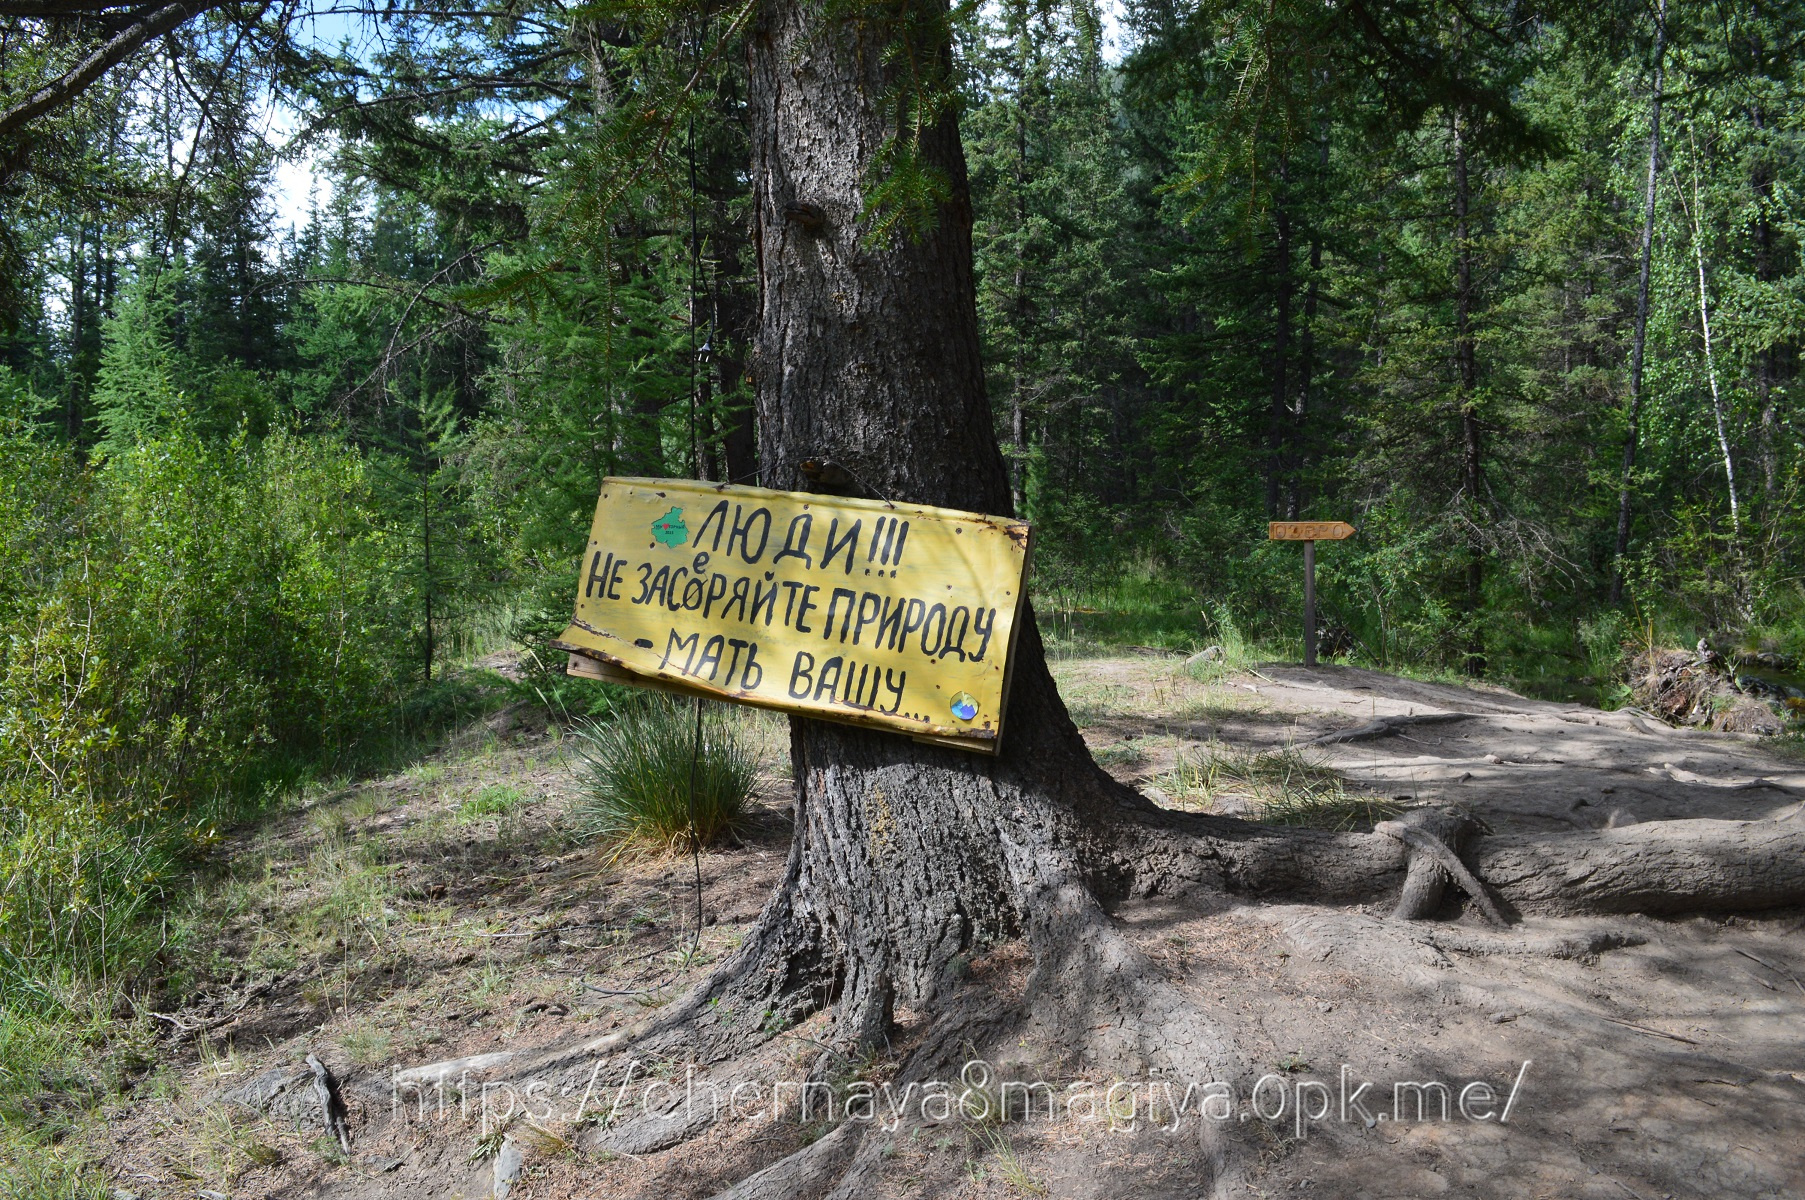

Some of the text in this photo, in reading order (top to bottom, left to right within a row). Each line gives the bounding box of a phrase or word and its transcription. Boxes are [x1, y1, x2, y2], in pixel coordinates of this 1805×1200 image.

[692, 499, 910, 579] ЛЮДИ!!!
[586, 550, 628, 600] НЕ
[823, 588, 997, 663] ПРИРОДУ
[659, 627, 763, 690] МАТЬ
[788, 650, 931, 724] ВАШУ...
